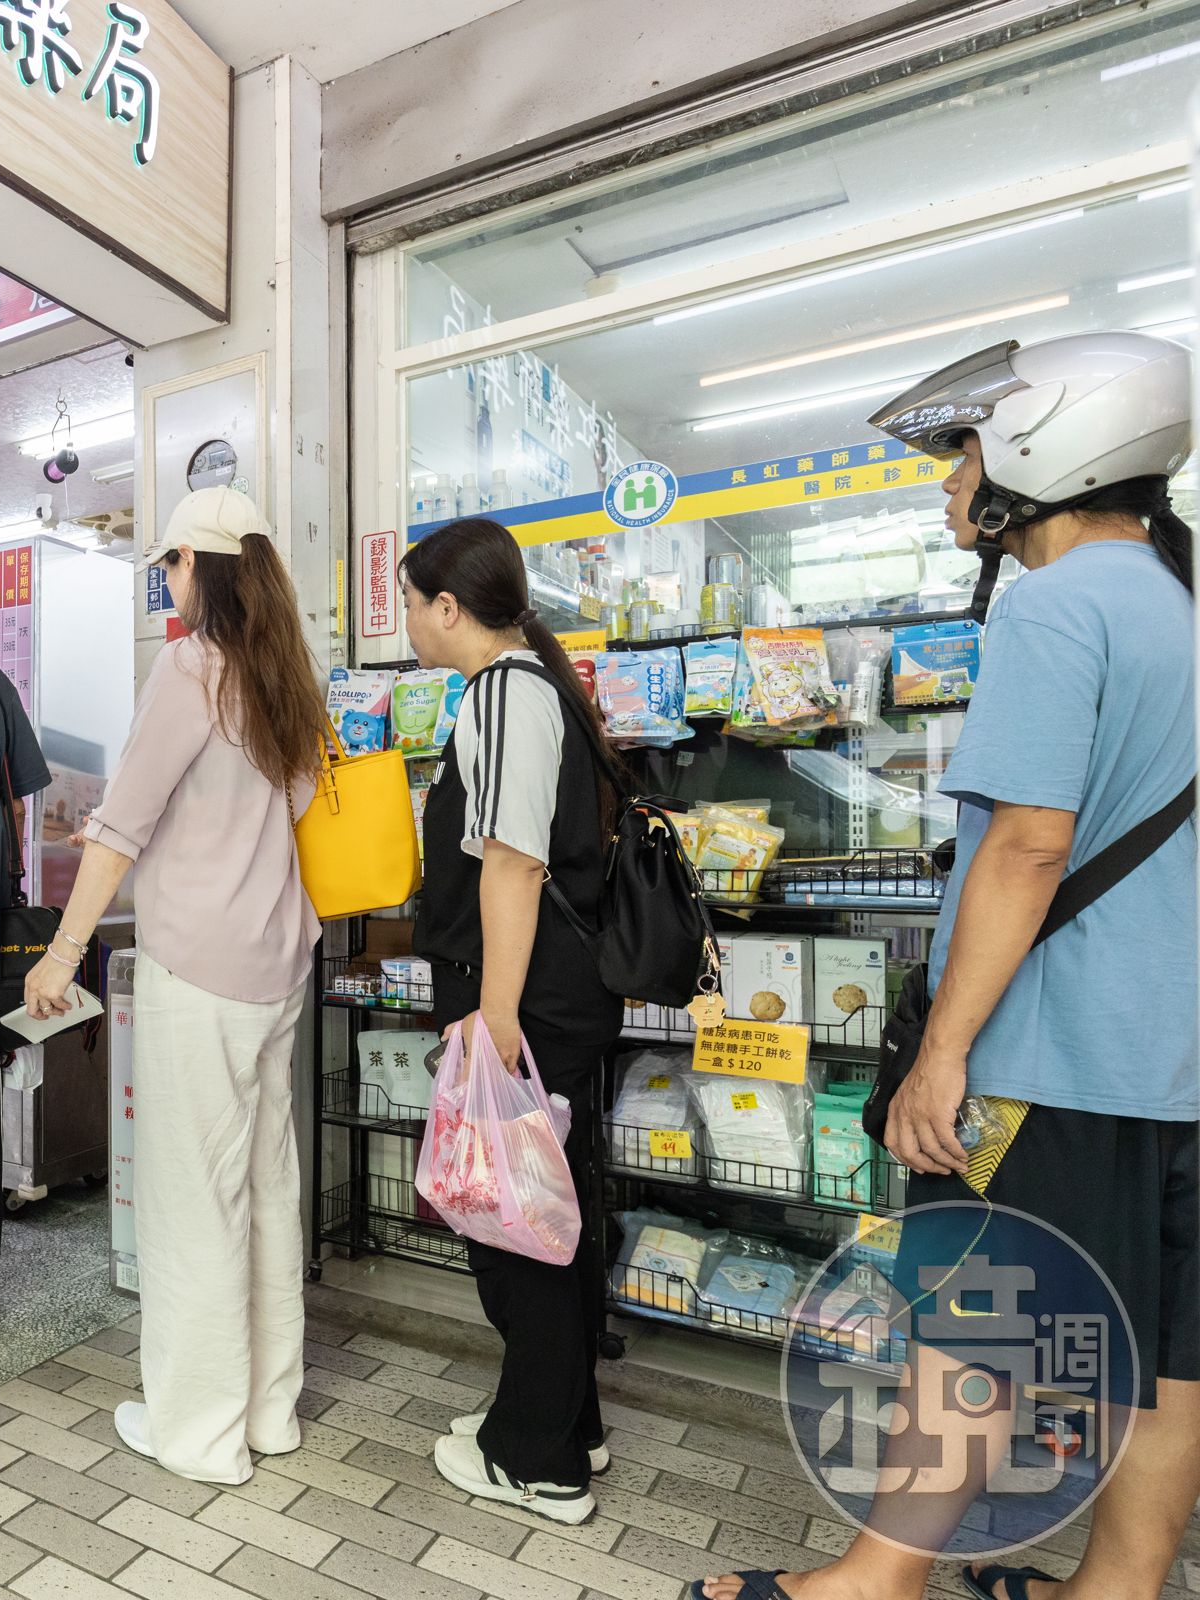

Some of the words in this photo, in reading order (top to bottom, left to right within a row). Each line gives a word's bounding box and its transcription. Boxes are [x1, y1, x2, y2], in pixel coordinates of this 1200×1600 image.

[626, 517, 651, 526] HEALTH
[369, 536, 388, 631] 錄影監視中
[405, 687, 430, 698] ACE
[368, 1050, 383, 1067] 茶
[393, 1051, 410, 1068] 茶
